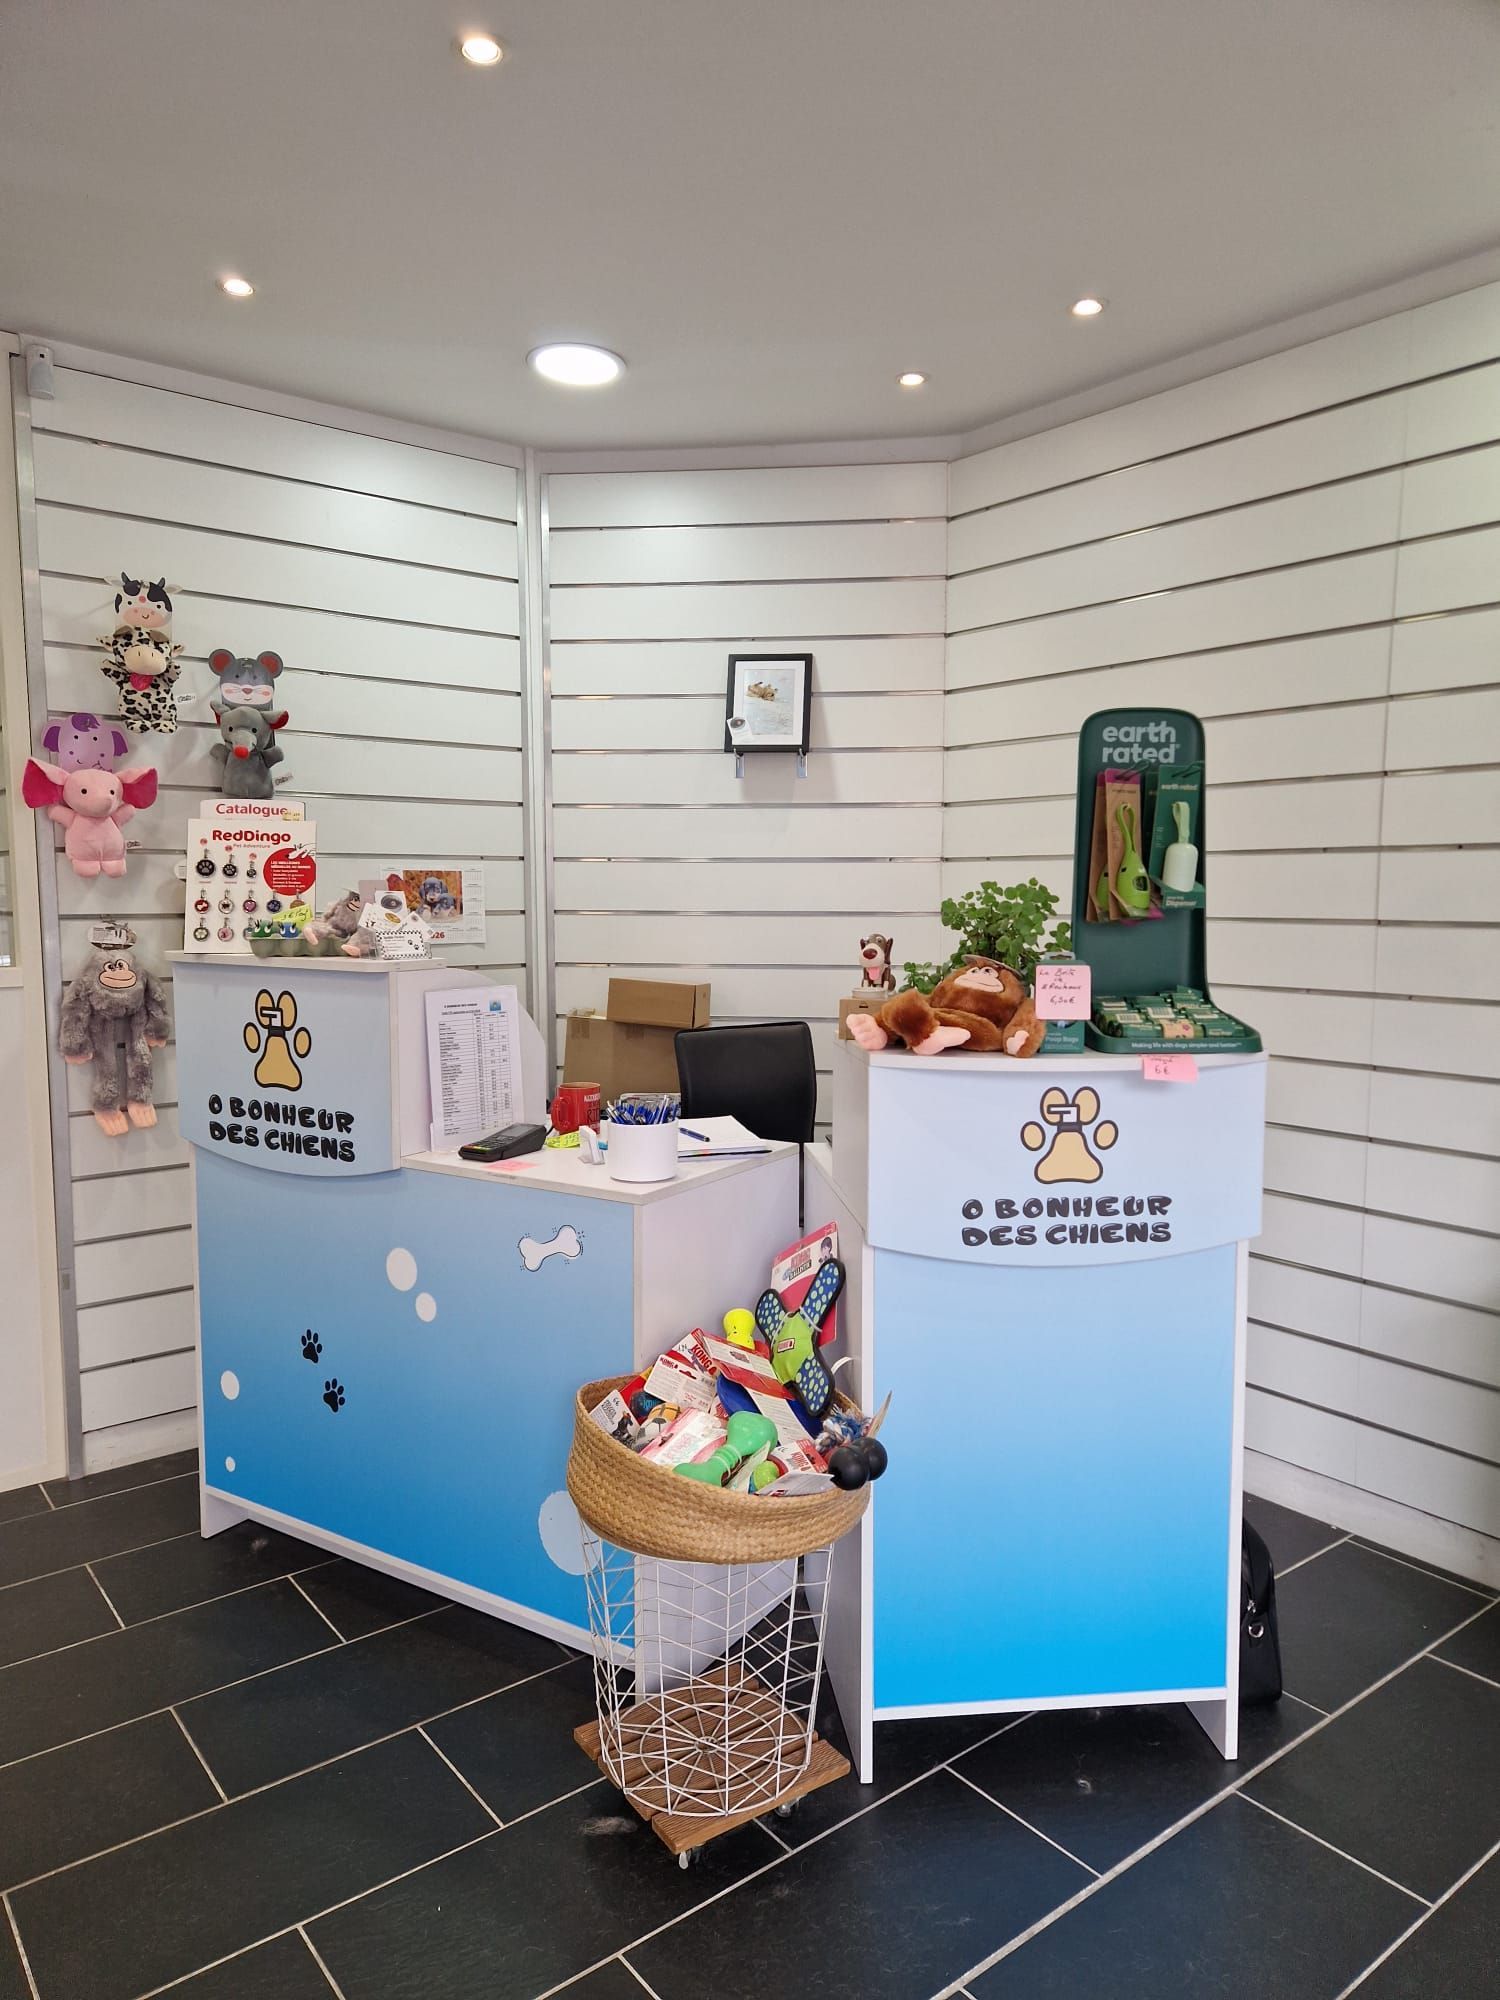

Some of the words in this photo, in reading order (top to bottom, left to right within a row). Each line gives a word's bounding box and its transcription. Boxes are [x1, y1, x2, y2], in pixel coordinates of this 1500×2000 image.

[1102, 721, 1176, 743] earth
[216, 803, 288, 817] Catalogue
[212, 830, 291, 845] RedDingo
[208, 1094, 223, 1115] O
[229, 1096, 355, 1134] BONHEUR
[209, 1120, 259, 1147] DES
[264, 1128, 355, 1163] CHIENS
[961, 1198, 984, 1220] O
[994, 1195, 1173, 1220] BONHEUR
[961, 1224, 1038, 1247] DES
[1045, 1221, 1173, 1245] CHIENS
[691, 1344, 713, 1370] KONG
